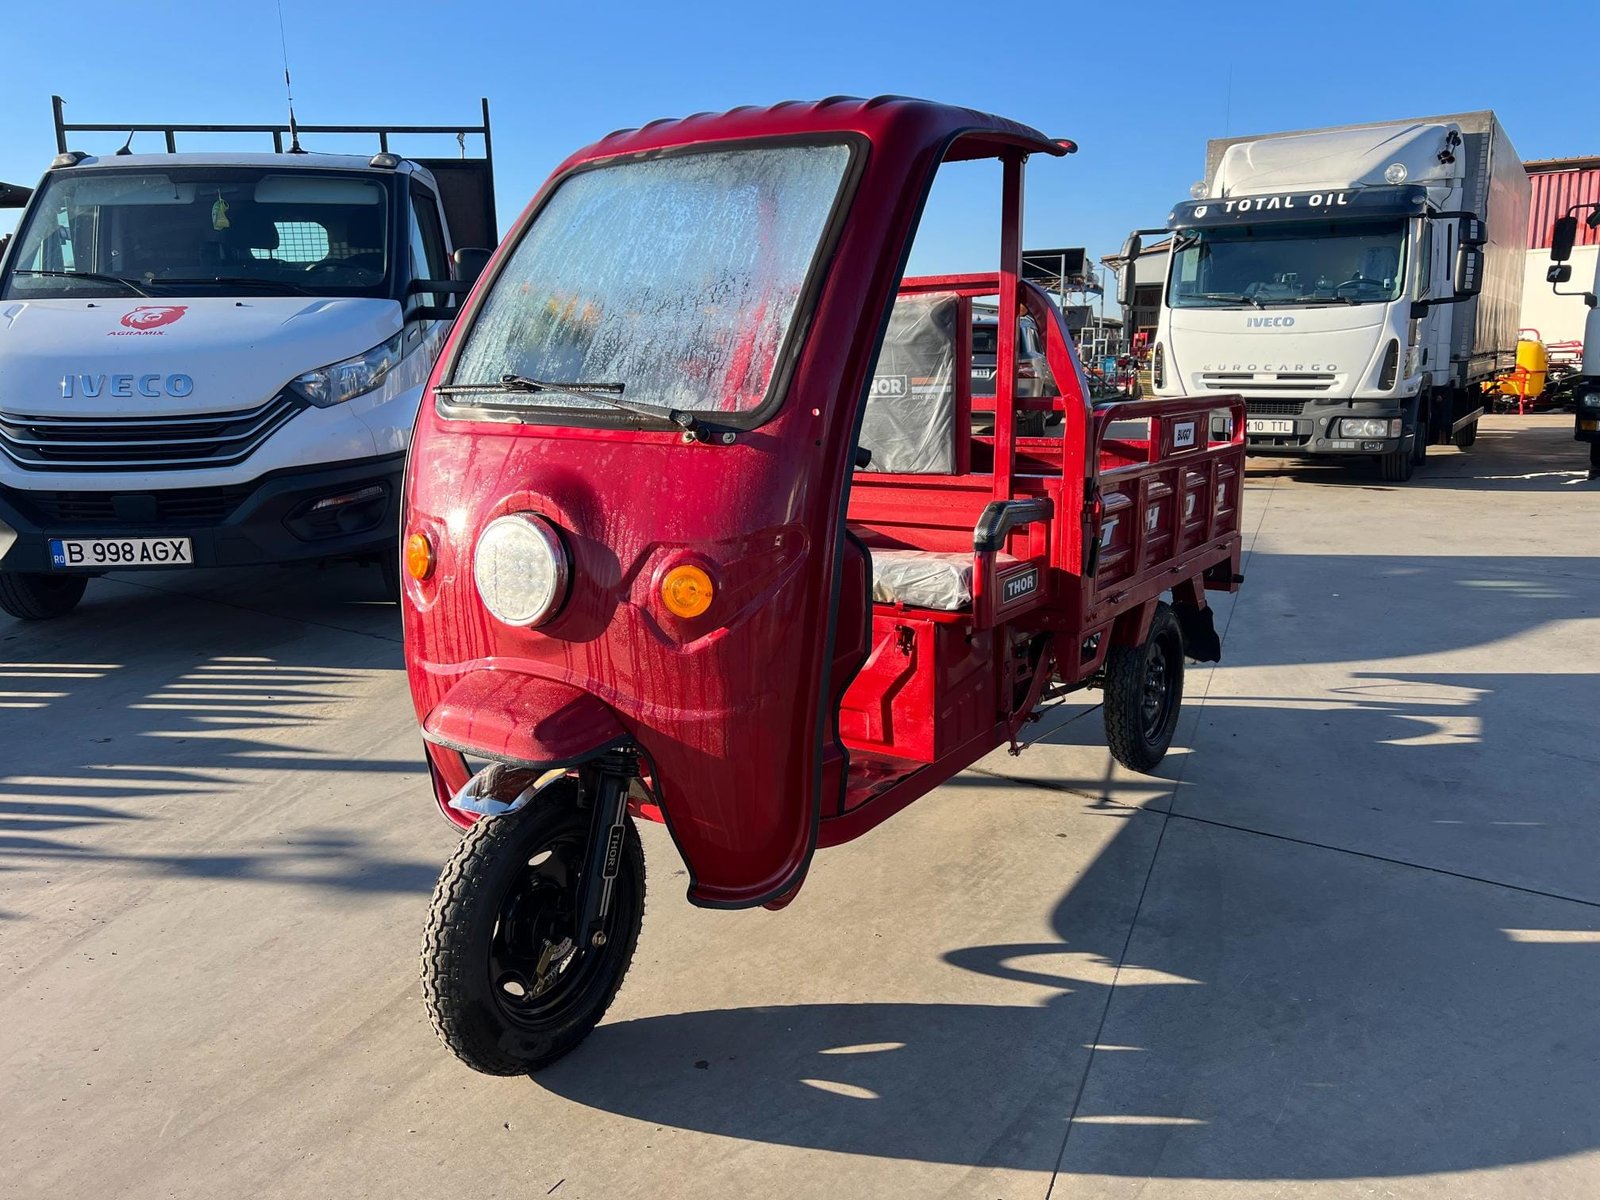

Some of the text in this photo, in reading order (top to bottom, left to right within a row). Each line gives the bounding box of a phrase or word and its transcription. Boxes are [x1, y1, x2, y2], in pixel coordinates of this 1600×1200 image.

[1225, 193, 1348, 213] TOTAL OIL
[1246, 316, 1295, 328] IVECO
[1203, 363, 1337, 372] EUROCARGO
[62, 373, 194, 398] IVECO
[1255, 421, 1264, 432] 10
[1272, 420, 1291, 432] TTL
[54, 554, 65, 564] RO
[67, 540, 187, 563] B 998 AGX
[1008, 575, 1034, 596] THOR
[608, 833, 620, 867] THOR
